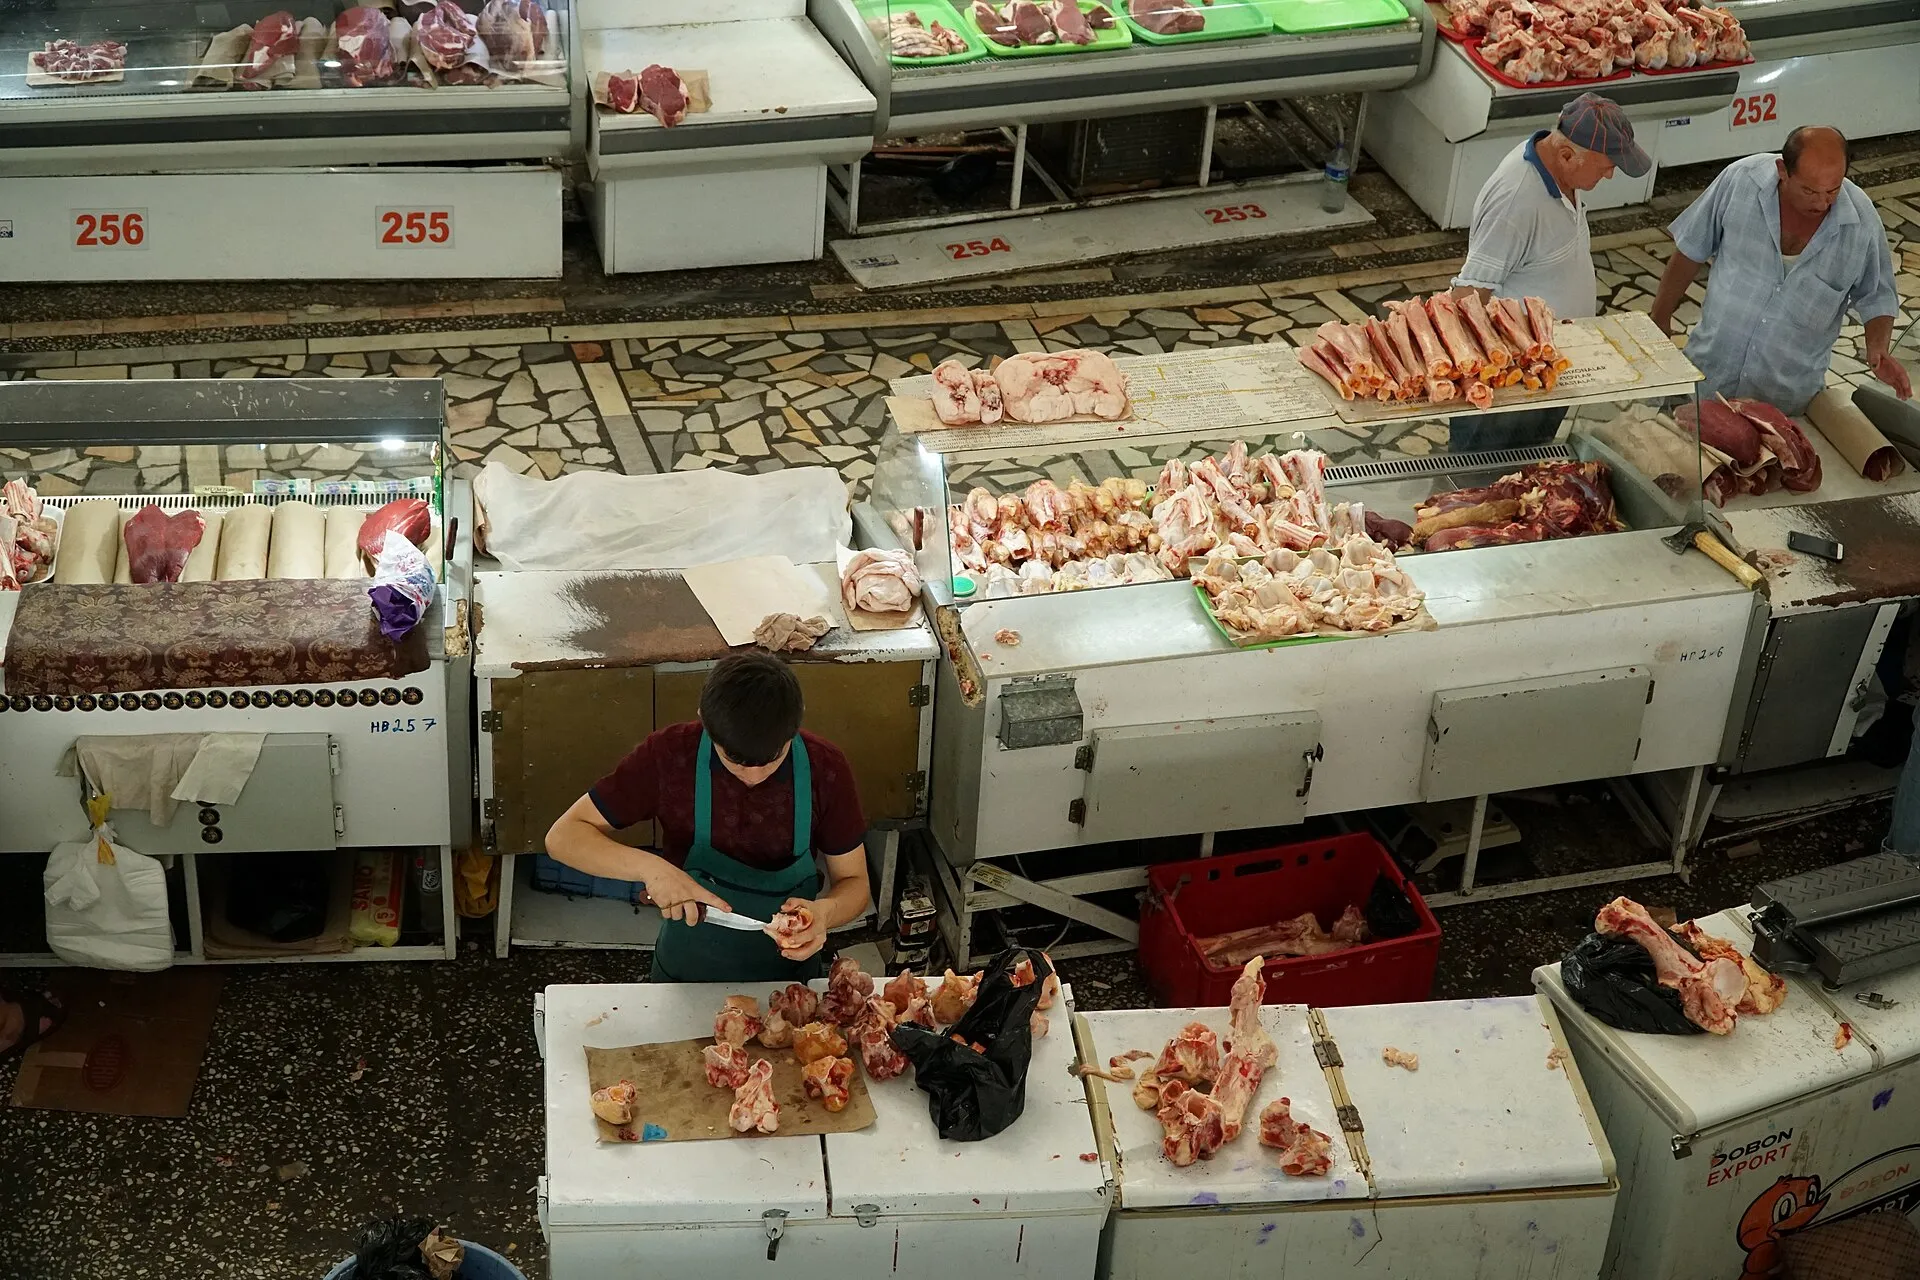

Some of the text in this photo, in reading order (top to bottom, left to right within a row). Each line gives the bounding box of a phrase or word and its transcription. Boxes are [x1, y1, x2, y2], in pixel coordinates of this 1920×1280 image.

[1732, 93, 1777, 126] 252
[76, 213, 144, 246] 256
[382, 211, 449, 243] 255
[1205, 204, 1267, 224] 253
[946, 237, 1010, 260] 254
[1711, 1127, 1794, 1169] DOBON
[1706, 1143, 1792, 1188] EXPORT
